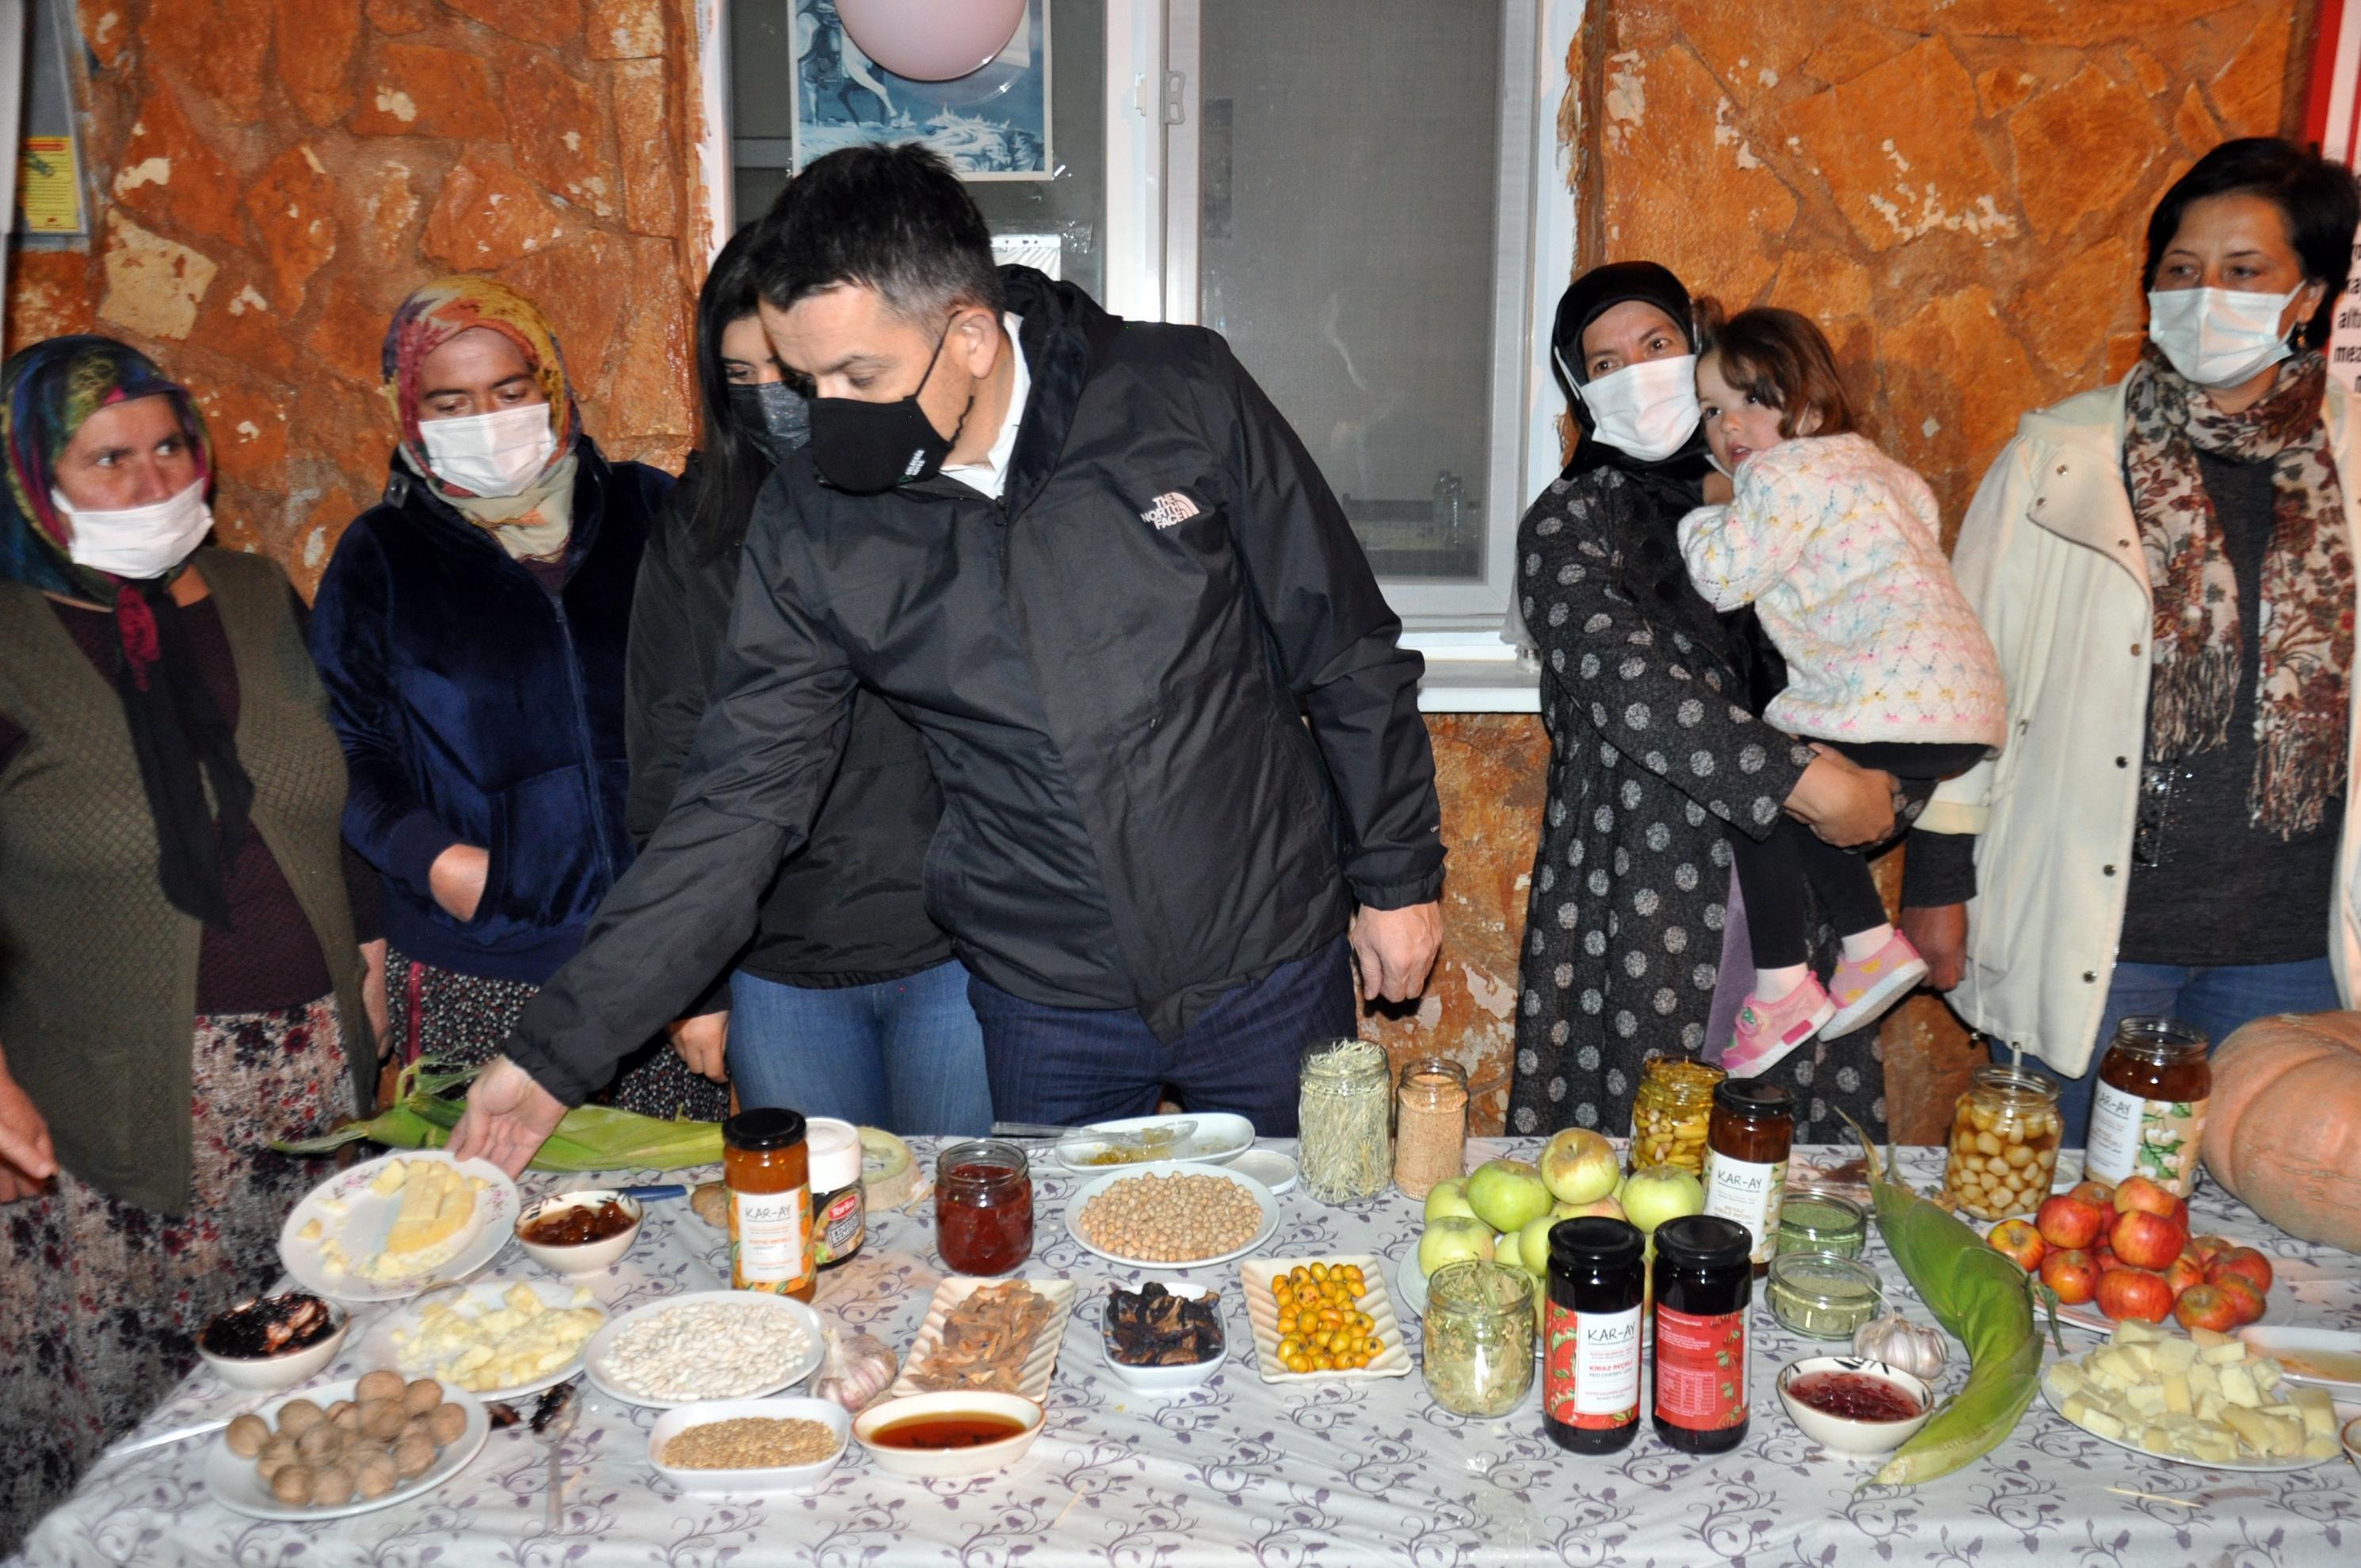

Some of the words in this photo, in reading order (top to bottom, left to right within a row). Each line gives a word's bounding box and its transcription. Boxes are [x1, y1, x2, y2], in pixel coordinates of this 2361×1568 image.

[1152, 493, 1175, 509] THE
[1140, 502, 1181, 523] NORTH
[1154, 511, 1185, 530] FACE
[2096, 1090, 2132, 1116] AR-AY
[1718, 1169, 1763, 1189] KAR-AY
[745, 1204, 791, 1219] KAR-AY
[830, 1198, 856, 1218] Torku
[1588, 1321, 1636, 1342] KAR-AY
